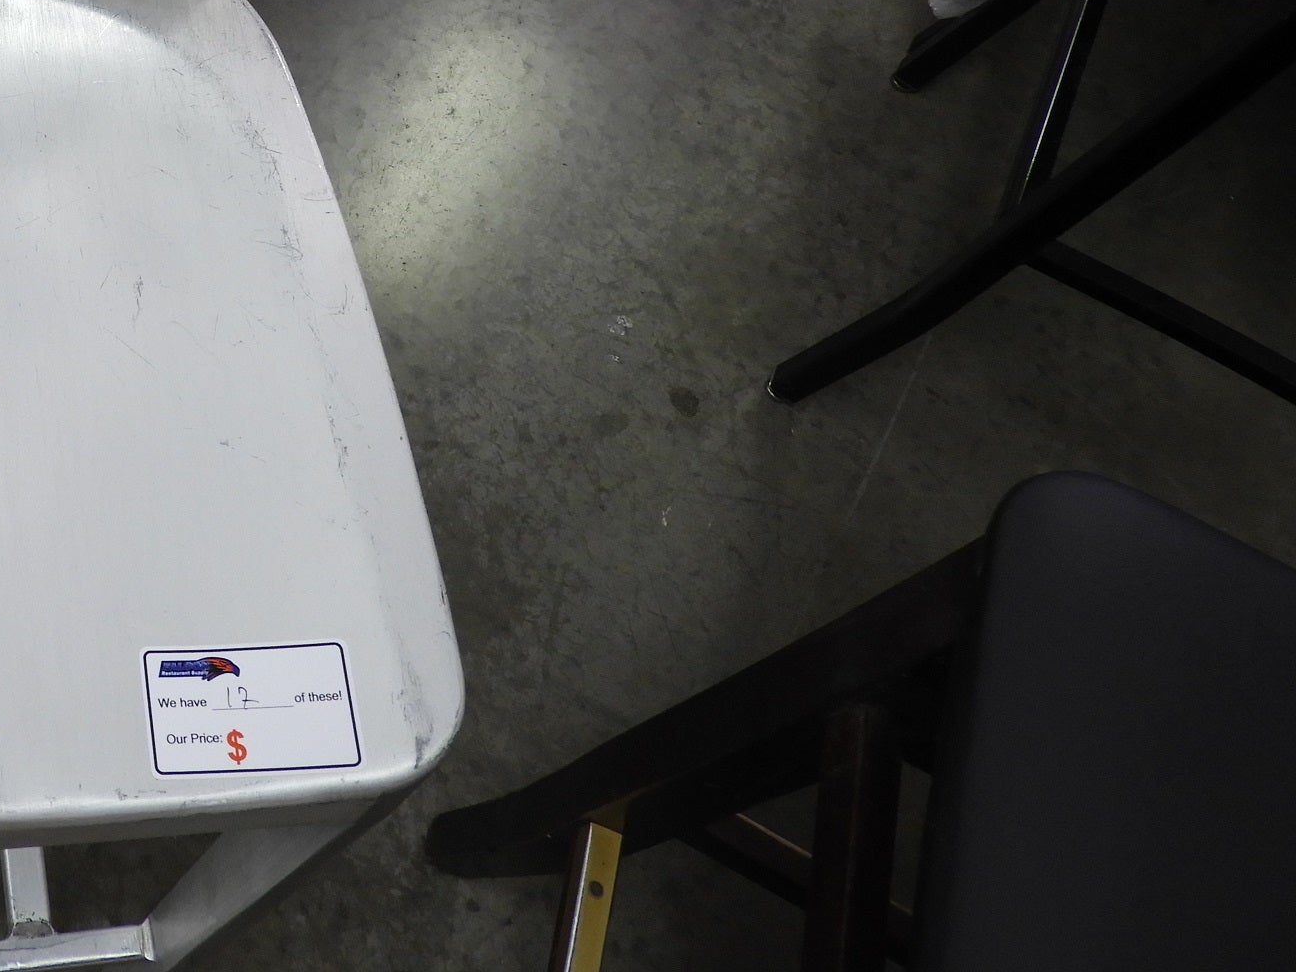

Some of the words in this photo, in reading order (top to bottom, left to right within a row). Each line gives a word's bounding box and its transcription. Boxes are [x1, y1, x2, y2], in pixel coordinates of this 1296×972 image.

[158, 697, 177, 708] We
[180, 697, 207, 708] have
[294, 693, 306, 703] of
[308, 690, 343, 703] these!
[166, 733, 187, 744] Our
[190, 733, 223, 744] Price:
[226, 729, 248, 765] $
